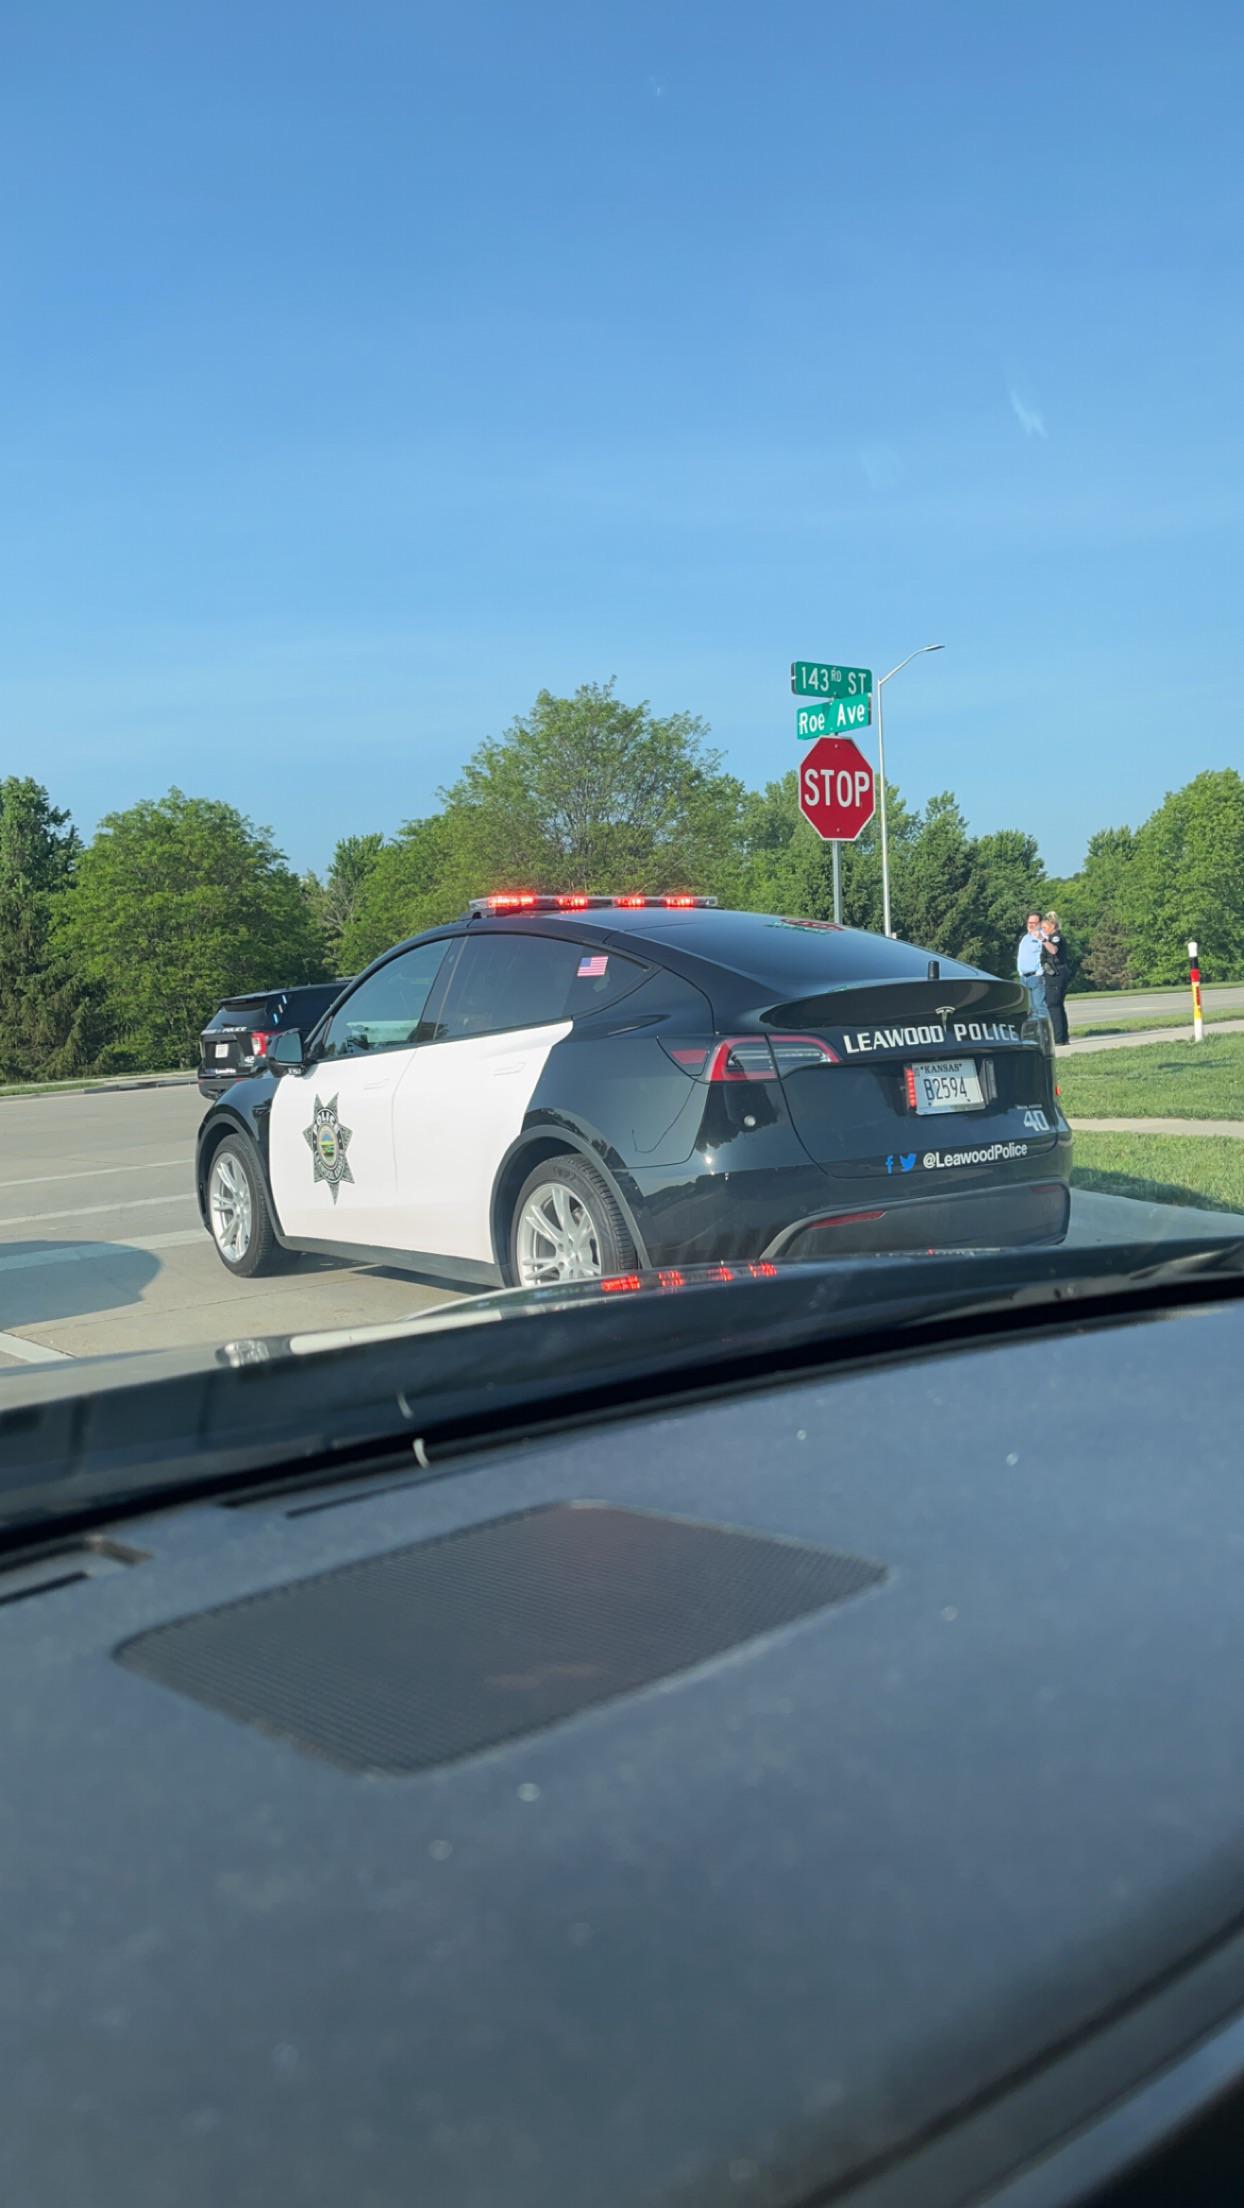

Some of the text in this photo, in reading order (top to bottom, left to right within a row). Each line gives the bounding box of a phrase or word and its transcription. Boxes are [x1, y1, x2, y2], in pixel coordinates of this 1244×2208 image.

[848, 672, 867, 695] ST
[799, 703, 865, 735] Roe Ave
[804, 768, 870, 808] STOP
[843, 1023, 1019, 1054] LEAWOOD POLICE
[924, 1063, 959, 1074] KANSAS
[923, 1075, 968, 1101] B2594
[1023, 1110, 1050, 1132] 40
[923, 1142, 1028, 1169] @LeawoodPolice
